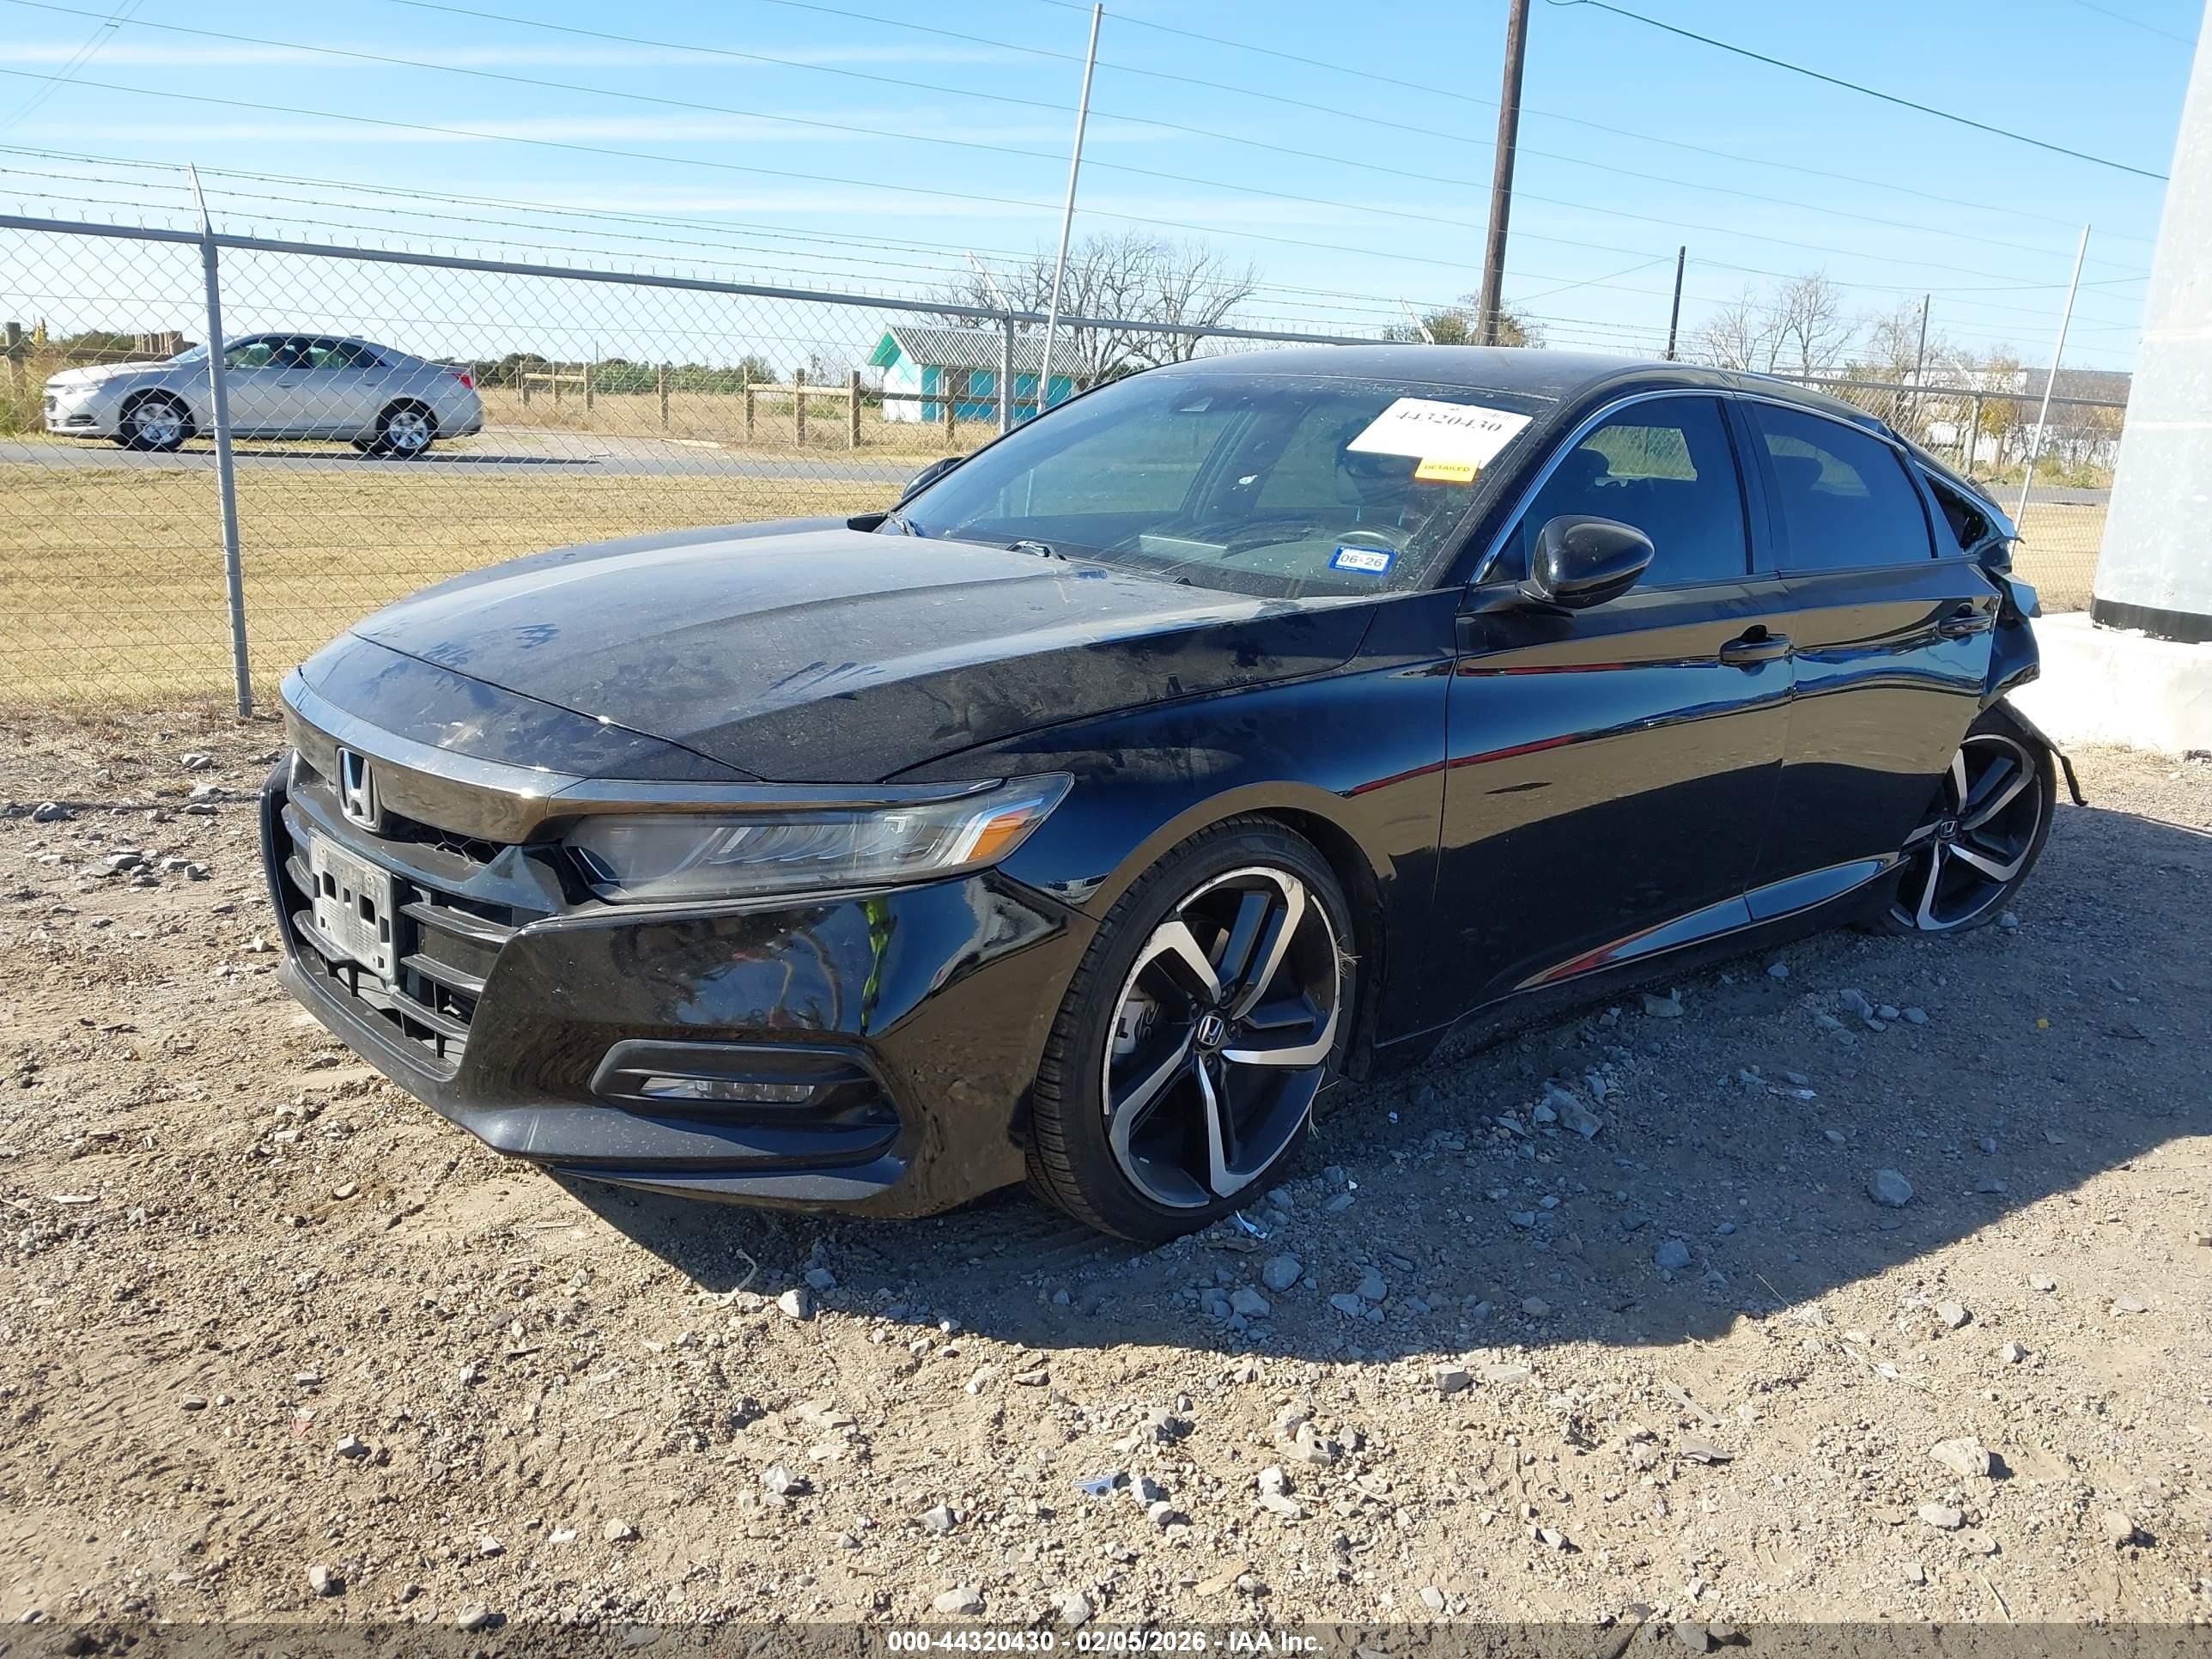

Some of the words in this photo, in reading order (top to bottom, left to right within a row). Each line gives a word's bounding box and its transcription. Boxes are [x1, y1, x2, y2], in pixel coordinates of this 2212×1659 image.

[1395, 410, 1503, 432] 44320430
[1424, 464, 1470, 472] DETAILED
[1340, 554, 1358, 563] 06
[1364, 556, 1383, 567] 26
